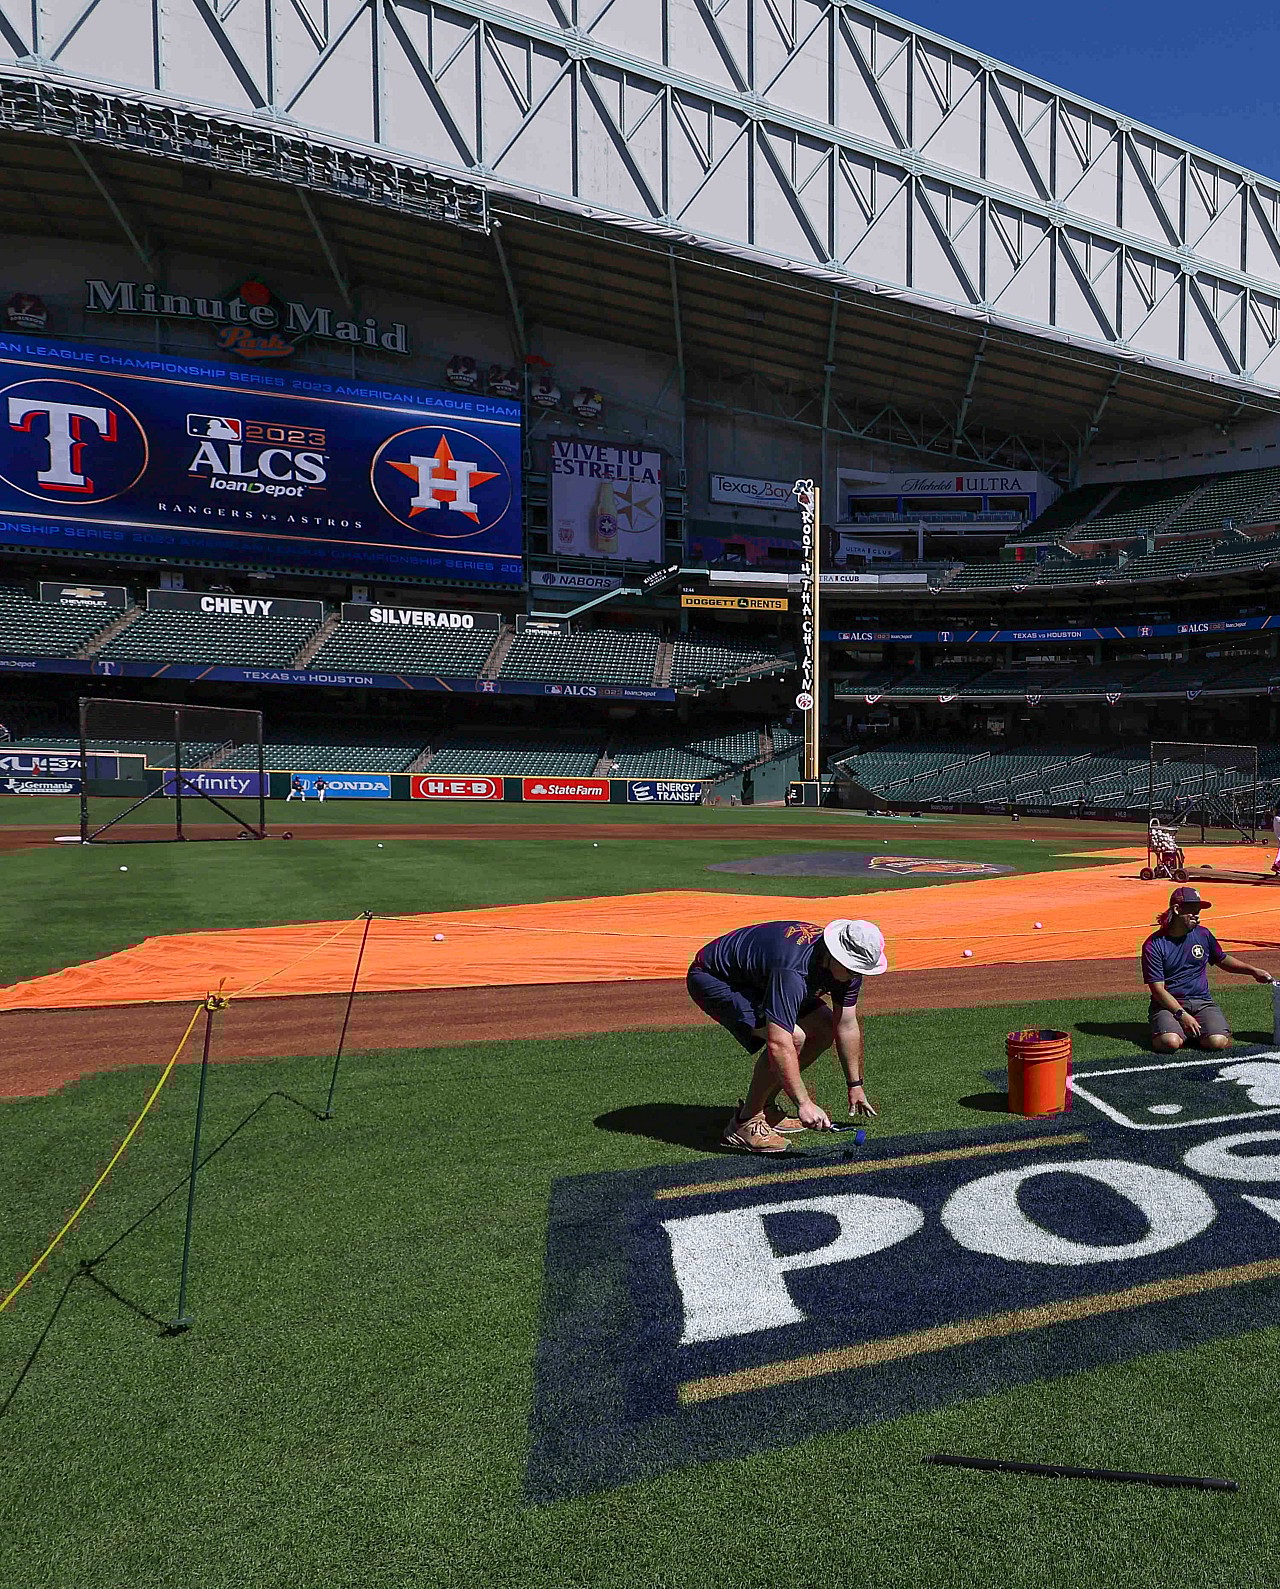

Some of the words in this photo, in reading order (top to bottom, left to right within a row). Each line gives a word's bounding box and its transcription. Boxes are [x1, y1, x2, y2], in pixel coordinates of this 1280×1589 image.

[86, 280, 276, 322] Minute
[286, 302, 409, 354] Maid
[217, 327, 286, 351] Park
[26, 346, 95, 362] LEAGUE
[99, 354, 226, 378] CHAMPIONSHIP
[229, 371, 285, 387] SERIES
[292, 379, 332, 393] 2023
[335, 386, 414, 404] AMERICAN
[416, 396, 472, 411] LEAGUE
[8, 397, 118, 494] T
[246, 426, 326, 446] 2023
[188, 440, 327, 484] ALCS
[616, 447, 643, 466] TU
[552, 457, 661, 485] ESTRELLA!
[210, 477, 305, 498] loanDepot
[410, 455, 479, 513] H
[716, 476, 758, 495] Texas
[762, 482, 794, 503] Bay
[901, 478, 952, 492] Michelob
[966, 477, 1022, 491] ULTRA
[158, 502, 253, 519] RANGERS
[286, 514, 363, 529] ASTROS
[64, 527, 124, 541] SERIES
[132, 533, 175, 545] 2023
[445, 559, 494, 571] SERIES
[559, 575, 612, 588] NABORS
[60, 598, 107, 607] CHEVROLET
[200, 596, 273, 616] CHEVY
[686, 598, 736, 607] DOGGETT
[750, 599, 782, 609] RENTS
[369, 607, 474, 629] SILVERADO
[1189, 623, 1209, 632] ALCS
[525, 628, 562, 636] CHEVROLET
[850, 632, 873, 641] ALCS
[801, 620, 813, 691] CHIKIN
[98, 660, 116, 676] T
[243, 671, 290, 681] TEXAS
[309, 673, 373, 685] HOUSTON
[563, 685, 597, 696] ALCS
[624, 689, 656, 698] loanDepot
[24, 781, 74, 789] Germania
[326, 781, 390, 791] ONDA
[428, 781, 488, 794] H-E-B
[656, 782, 696, 791] ENERGY
